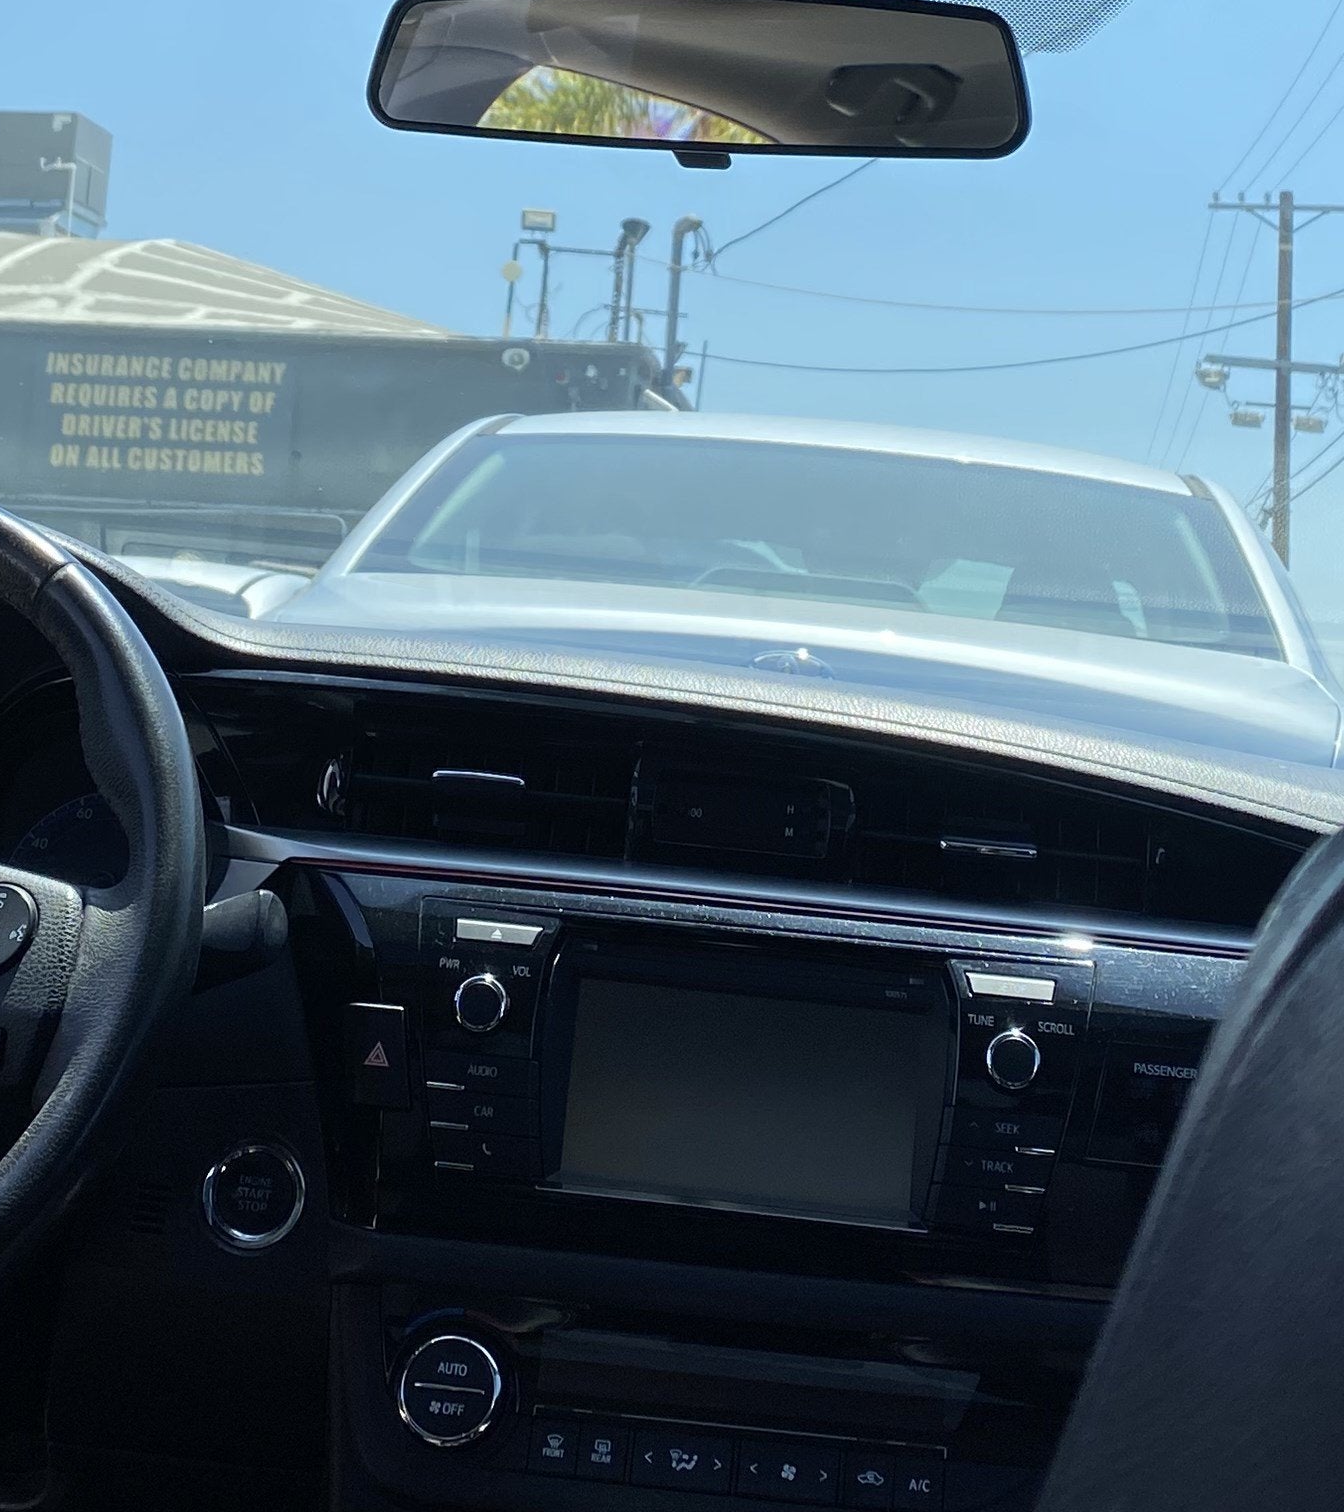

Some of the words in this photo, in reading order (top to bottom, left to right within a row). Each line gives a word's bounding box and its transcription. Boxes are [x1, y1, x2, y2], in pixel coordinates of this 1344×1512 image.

[46, 351, 173, 380] INSURANCE
[177, 356, 286, 385] COMPANY
[50, 382, 158, 409] REQUIRES
[163, 387, 178, 409] A
[183, 388, 244, 412] COPY
[248, 391, 276, 414] OF
[62, 413, 163, 440] DRIVER'S
[168, 418, 258, 445] LICENSE
[49, 443, 81, 468] ON
[86, 446, 121, 469] ALL
[126, 448, 265, 477] CUSTOMERS
[76, 808, 94, 819] 60
[786, 804, 795, 815] H
[30, 837, 49, 849] 40
[439, 957, 461, 969] PWR
[512, 965, 532, 977] VOL
[967, 1013, 996, 1027] TUNE
[1037, 1021, 1075, 1036] SCROLL
[467, 1064, 498, 1078] AUDIO
[473, 1105, 494, 1118] CAR
[995, 1122, 1021, 1135] SEEK
[980, 1159, 1015, 1173] TRACK
[237, 1187, 272, 1200] START
[238, 1200, 268, 1212] STOP
[437, 1361, 468, 1377] AUTO
[442, 1402, 465, 1416] OFF
[908, 1478, 931, 1493] A/C
